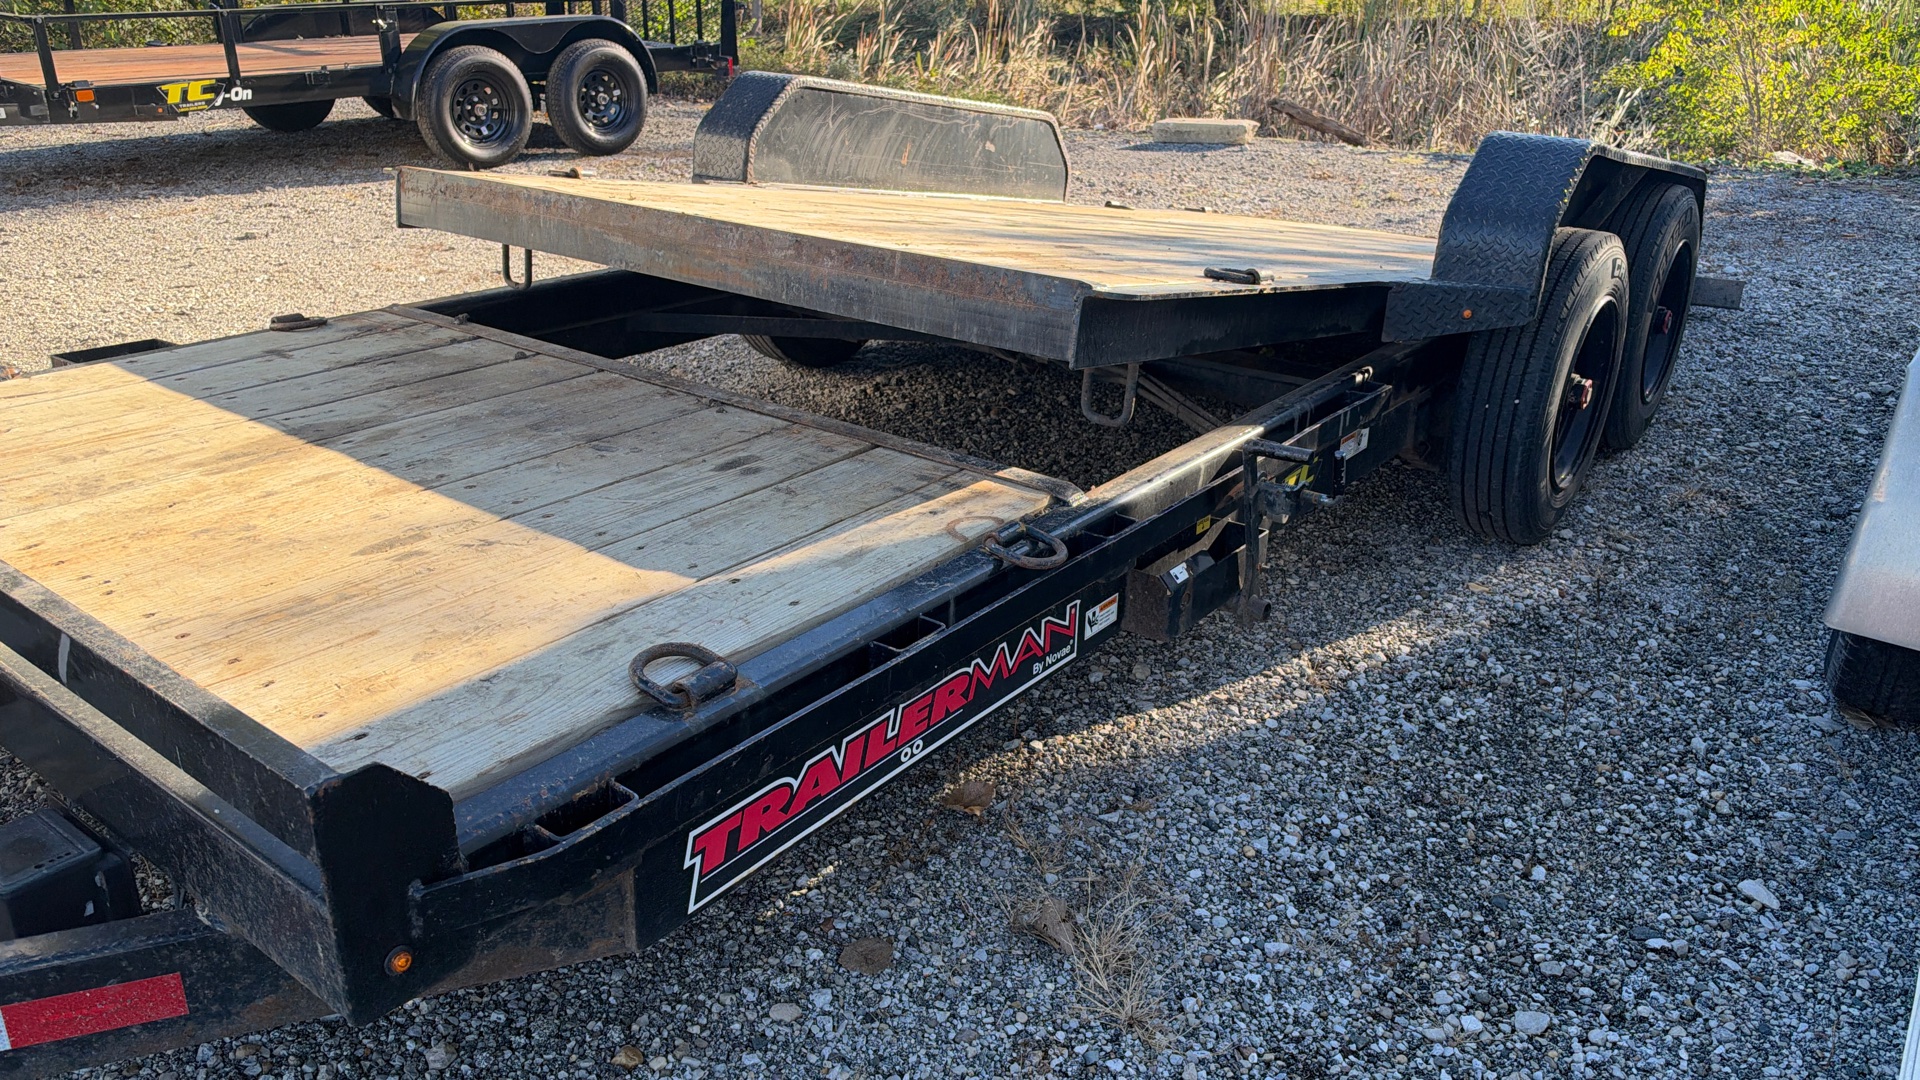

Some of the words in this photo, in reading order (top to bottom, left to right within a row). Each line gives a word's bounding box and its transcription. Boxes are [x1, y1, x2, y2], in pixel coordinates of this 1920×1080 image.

[161, 79, 216, 104] TC
[1032, 661, 1045, 675] By
[694, 606, 1076, 876] TRAILERMAN
